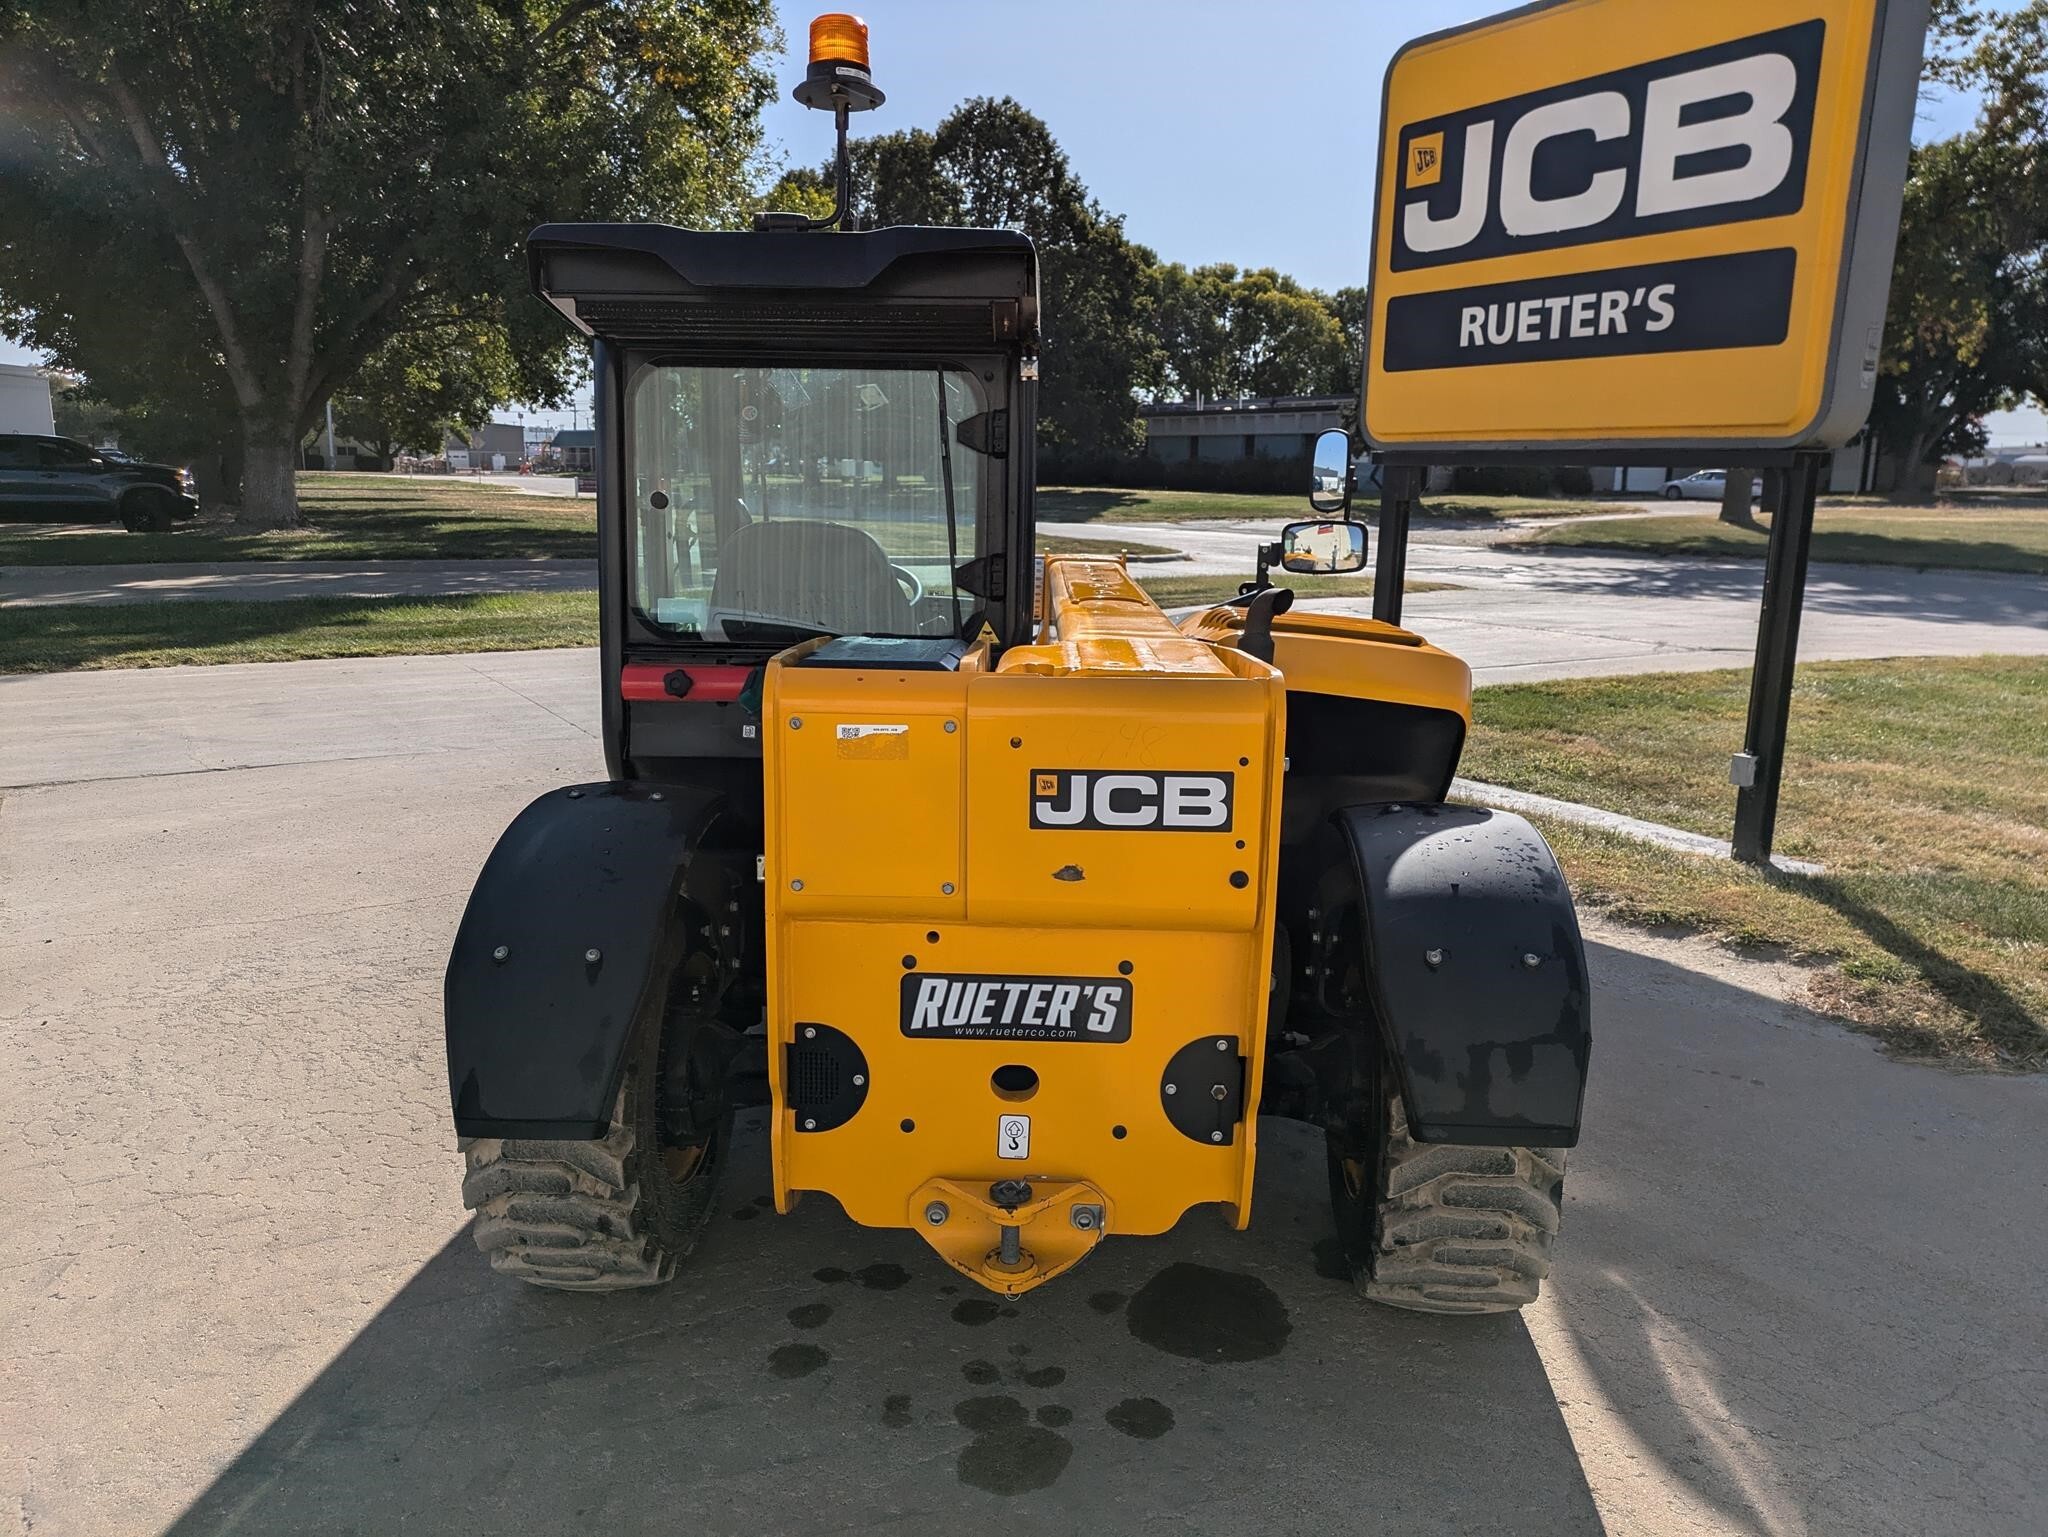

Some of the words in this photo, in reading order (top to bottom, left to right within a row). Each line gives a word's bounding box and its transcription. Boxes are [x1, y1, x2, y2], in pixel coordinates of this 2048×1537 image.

[1404, 53, 1797, 253] JCB
[1416, 149, 1436, 173] JCB
[1459, 284, 1676, 348] RUETER'S
[1036, 775, 1228, 827] JCB
[910, 978, 1123, 1033] RUETER'S
[954, 1026, 1078, 1038] www.rueterco.com
